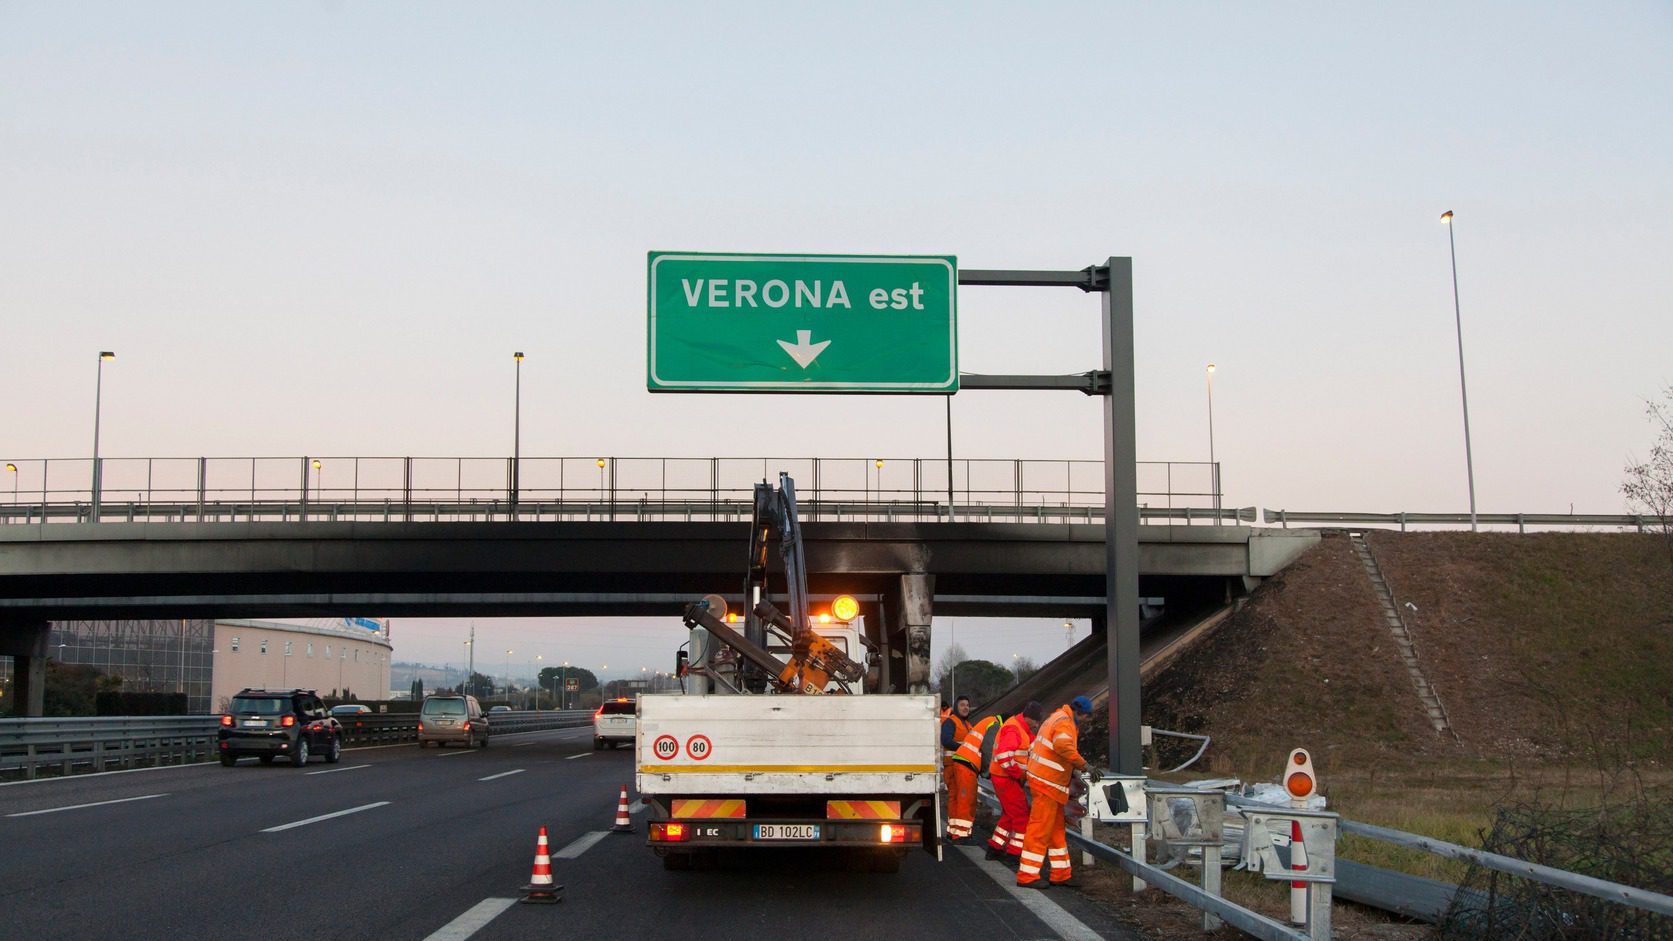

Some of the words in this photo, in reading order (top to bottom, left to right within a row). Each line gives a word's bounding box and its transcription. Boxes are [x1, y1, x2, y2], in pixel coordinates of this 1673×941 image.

[682, 279, 851, 308] VERONA
[869, 281, 924, 310] est
[659, 741, 675, 752] 100
[693, 742, 705, 752] 80
[760, 826, 775, 838] BD
[780, 826, 813, 838] 102LC
